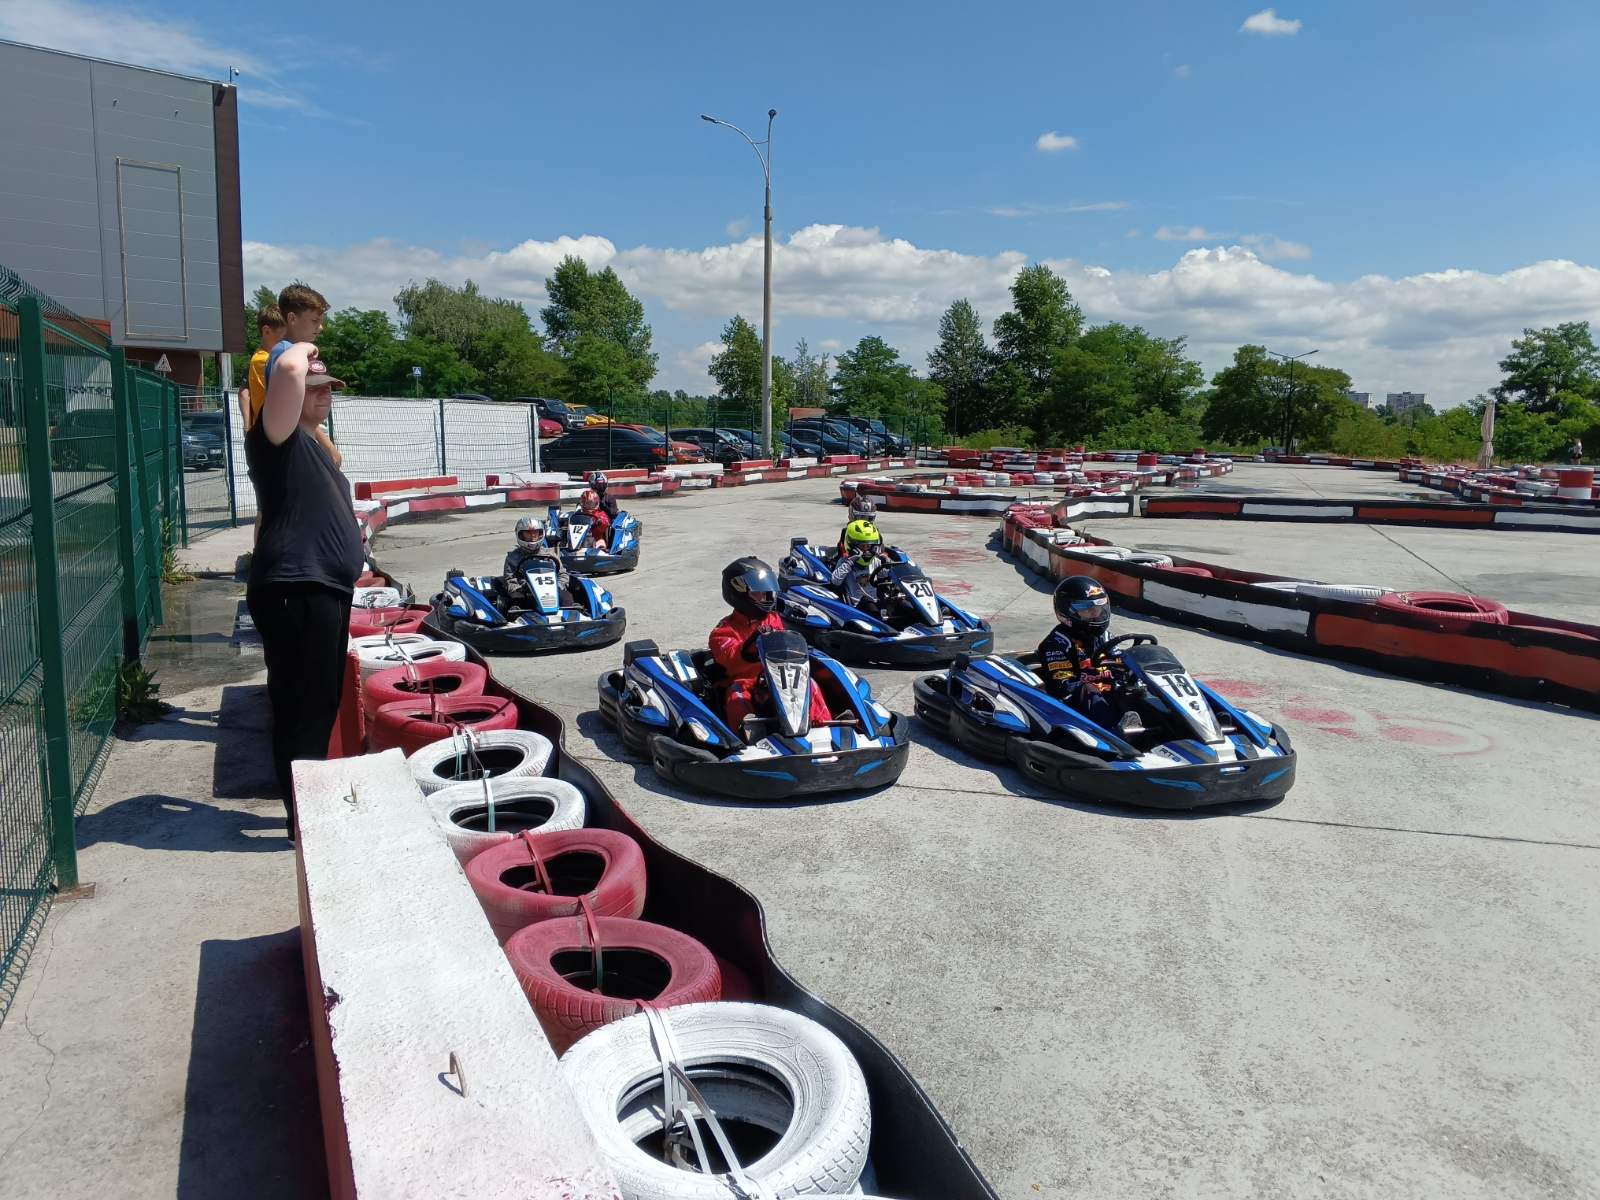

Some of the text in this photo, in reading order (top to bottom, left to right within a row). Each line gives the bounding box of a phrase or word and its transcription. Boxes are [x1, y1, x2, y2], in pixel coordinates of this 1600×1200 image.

[573, 525, 584, 534] 12
[535, 576, 555, 586] 15
[910, 583, 934, 598] 20
[777, 665, 802, 690] 17
[1161, 674, 1199, 698] 18
